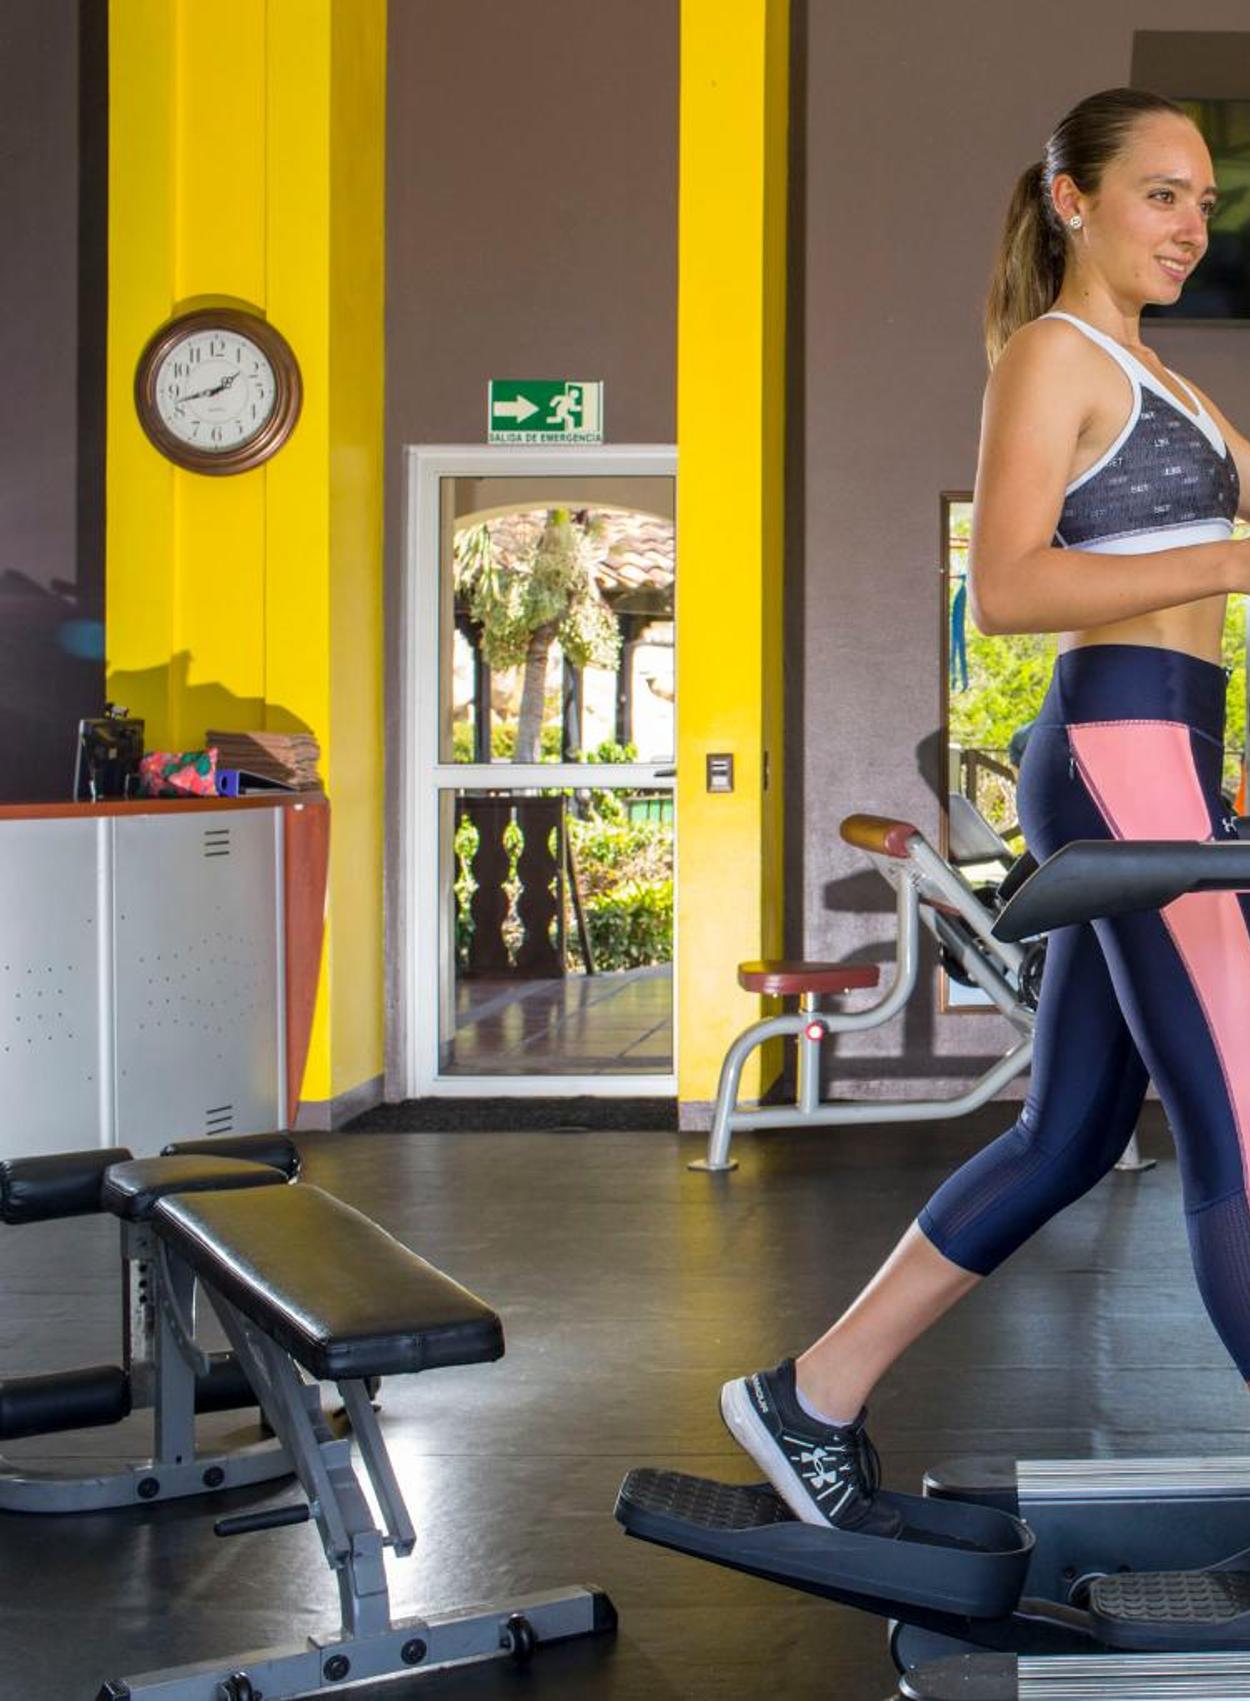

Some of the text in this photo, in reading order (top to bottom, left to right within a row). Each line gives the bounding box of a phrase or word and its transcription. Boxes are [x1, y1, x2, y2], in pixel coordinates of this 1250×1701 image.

[189, 347, 201, 364] 11
[210, 340, 226, 358] 12
[173, 362, 190, 379] 10
[248, 361, 260, 379] 2
[168, 384, 180, 399] 9
[256, 382, 265, 399] 3
[173, 403, 186, 418] 8
[190, 420, 201, 438] 7
[211, 426, 223, 442] 6
[234, 419, 244, 435] 5
[489, 433, 602, 442] SALIDA DE EMERGENCIA
